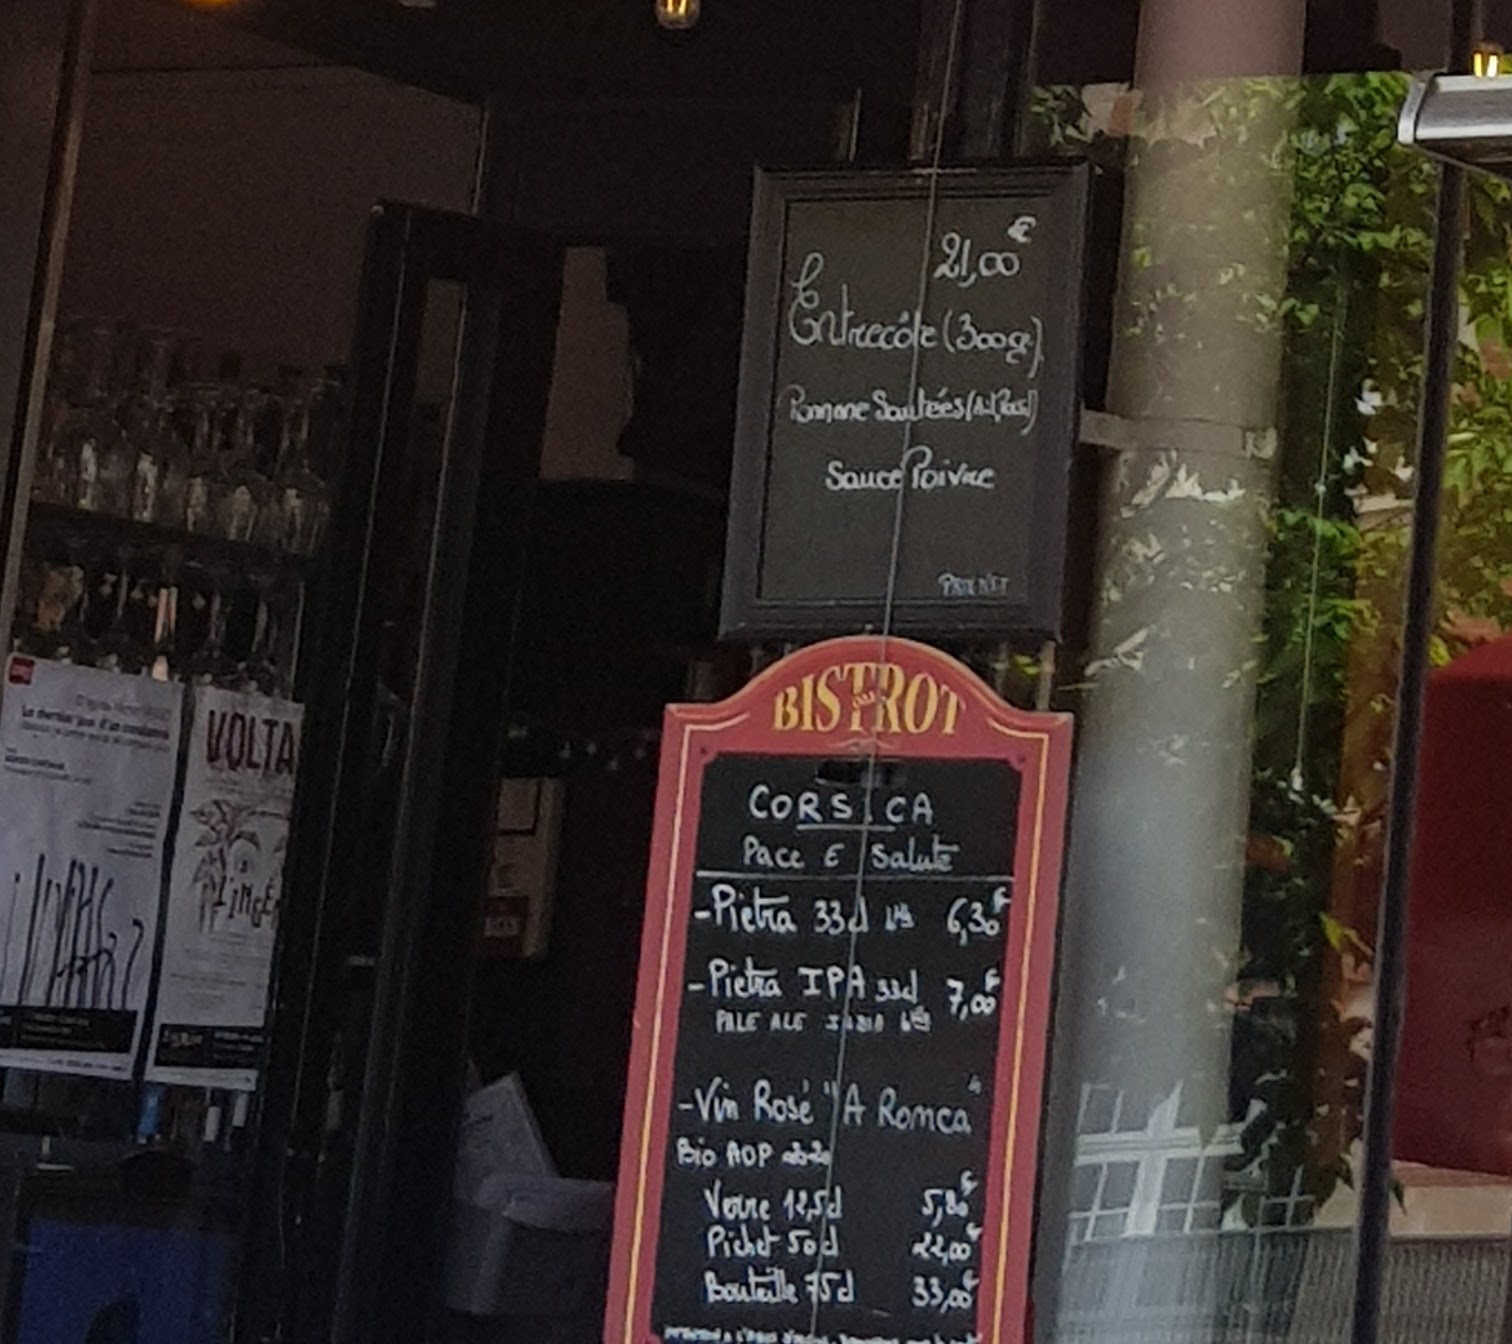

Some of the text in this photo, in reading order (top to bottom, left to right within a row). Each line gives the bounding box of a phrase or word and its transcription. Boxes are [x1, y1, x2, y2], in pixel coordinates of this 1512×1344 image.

[825, 446, 996, 491] Sauce Poivre
[773, 661, 967, 735] BISTROT
[207, 709, 296, 775] VOLTA
[749, 784, 935, 824] CORSICA
[798, 965, 866, 1000] IPA
[676, 1136, 717, 1167] Bio
